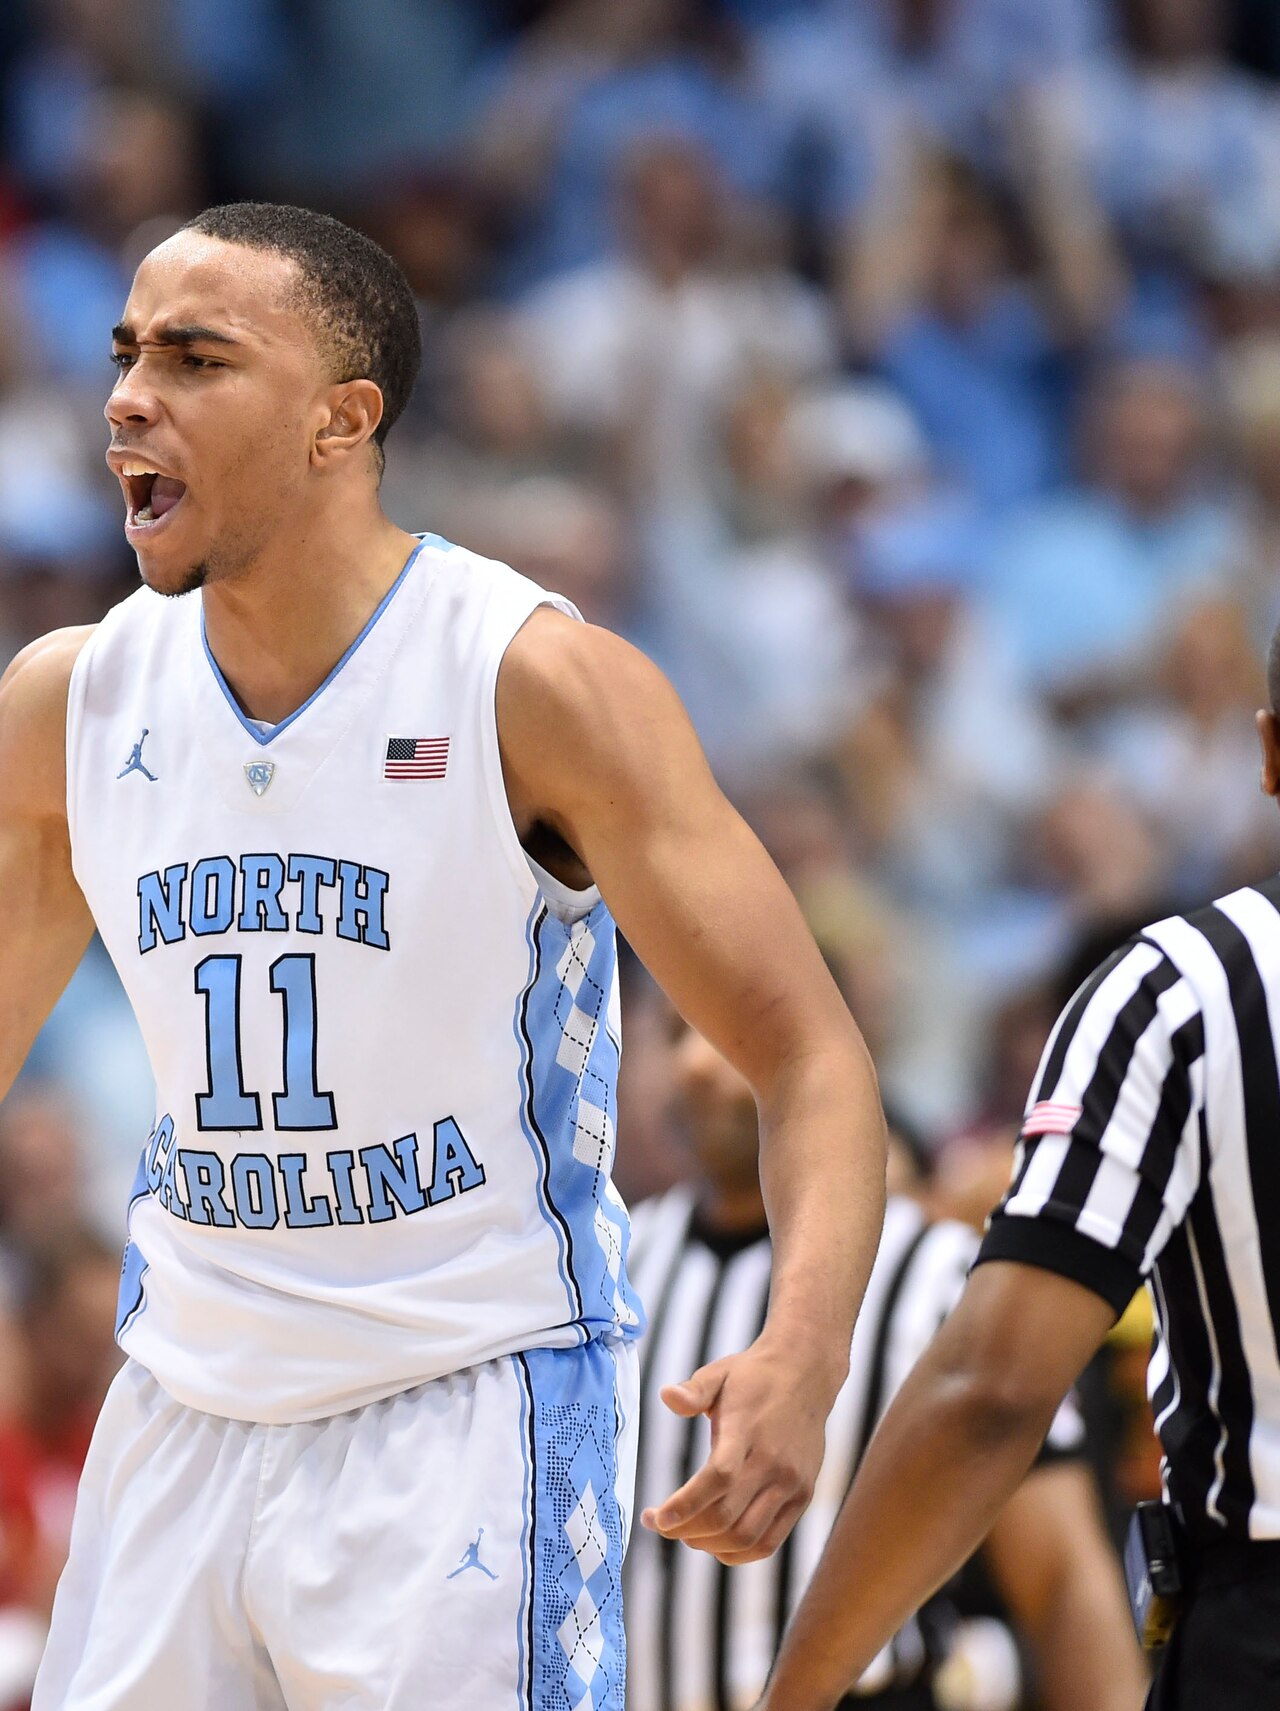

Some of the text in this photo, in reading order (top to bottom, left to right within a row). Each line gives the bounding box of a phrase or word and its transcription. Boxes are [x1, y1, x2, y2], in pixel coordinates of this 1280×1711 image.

[137, 853, 391, 956] NORTH
[194, 952, 339, 1131] 11
[146, 1112, 487, 1230] CAROLINA
